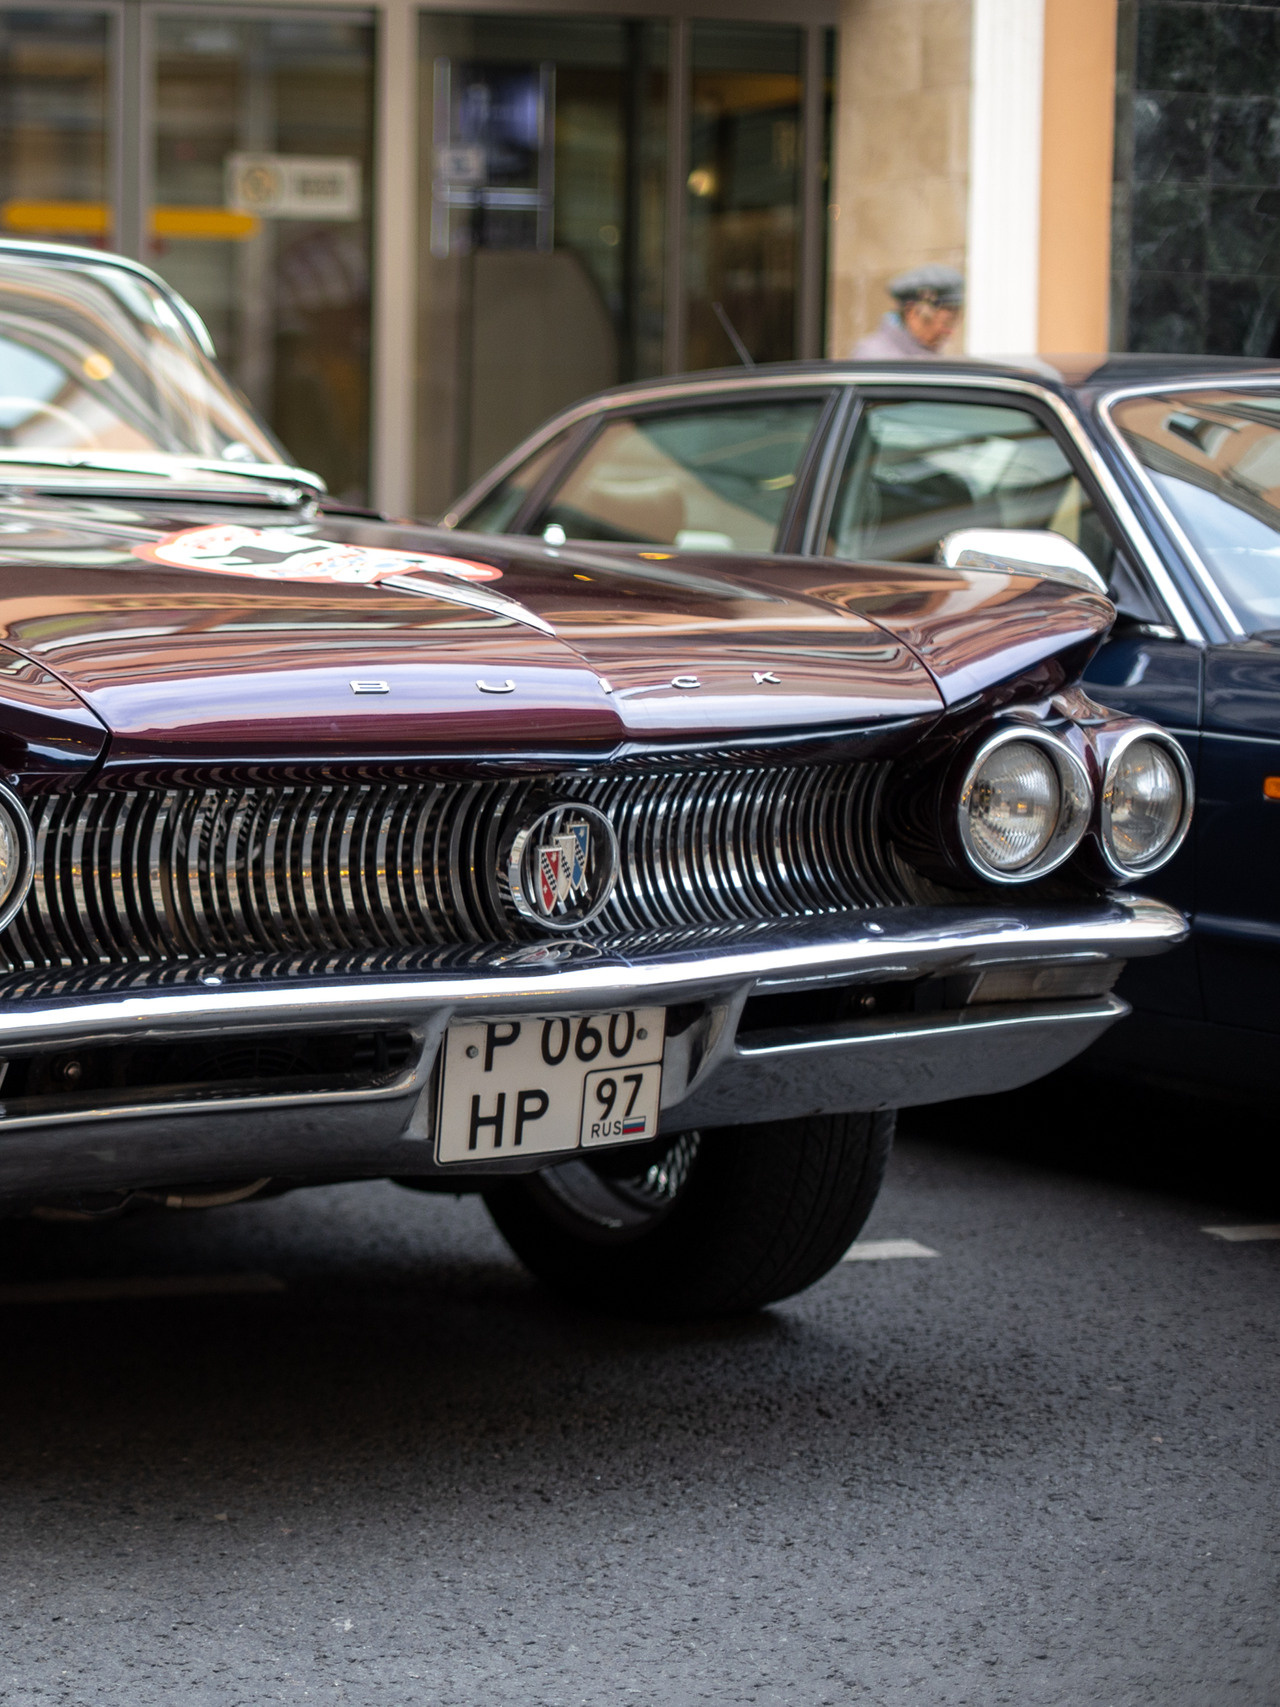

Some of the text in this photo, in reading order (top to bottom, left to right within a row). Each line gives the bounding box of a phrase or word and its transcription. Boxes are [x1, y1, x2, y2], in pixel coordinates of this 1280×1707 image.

[349, 671, 781, 694] BUICK
[483, 1011, 636, 1072] P 060
[467, 1088, 550, 1151] HP
[595, 1073, 644, 1121] 97
[591, 1120, 622, 1139] RUS
